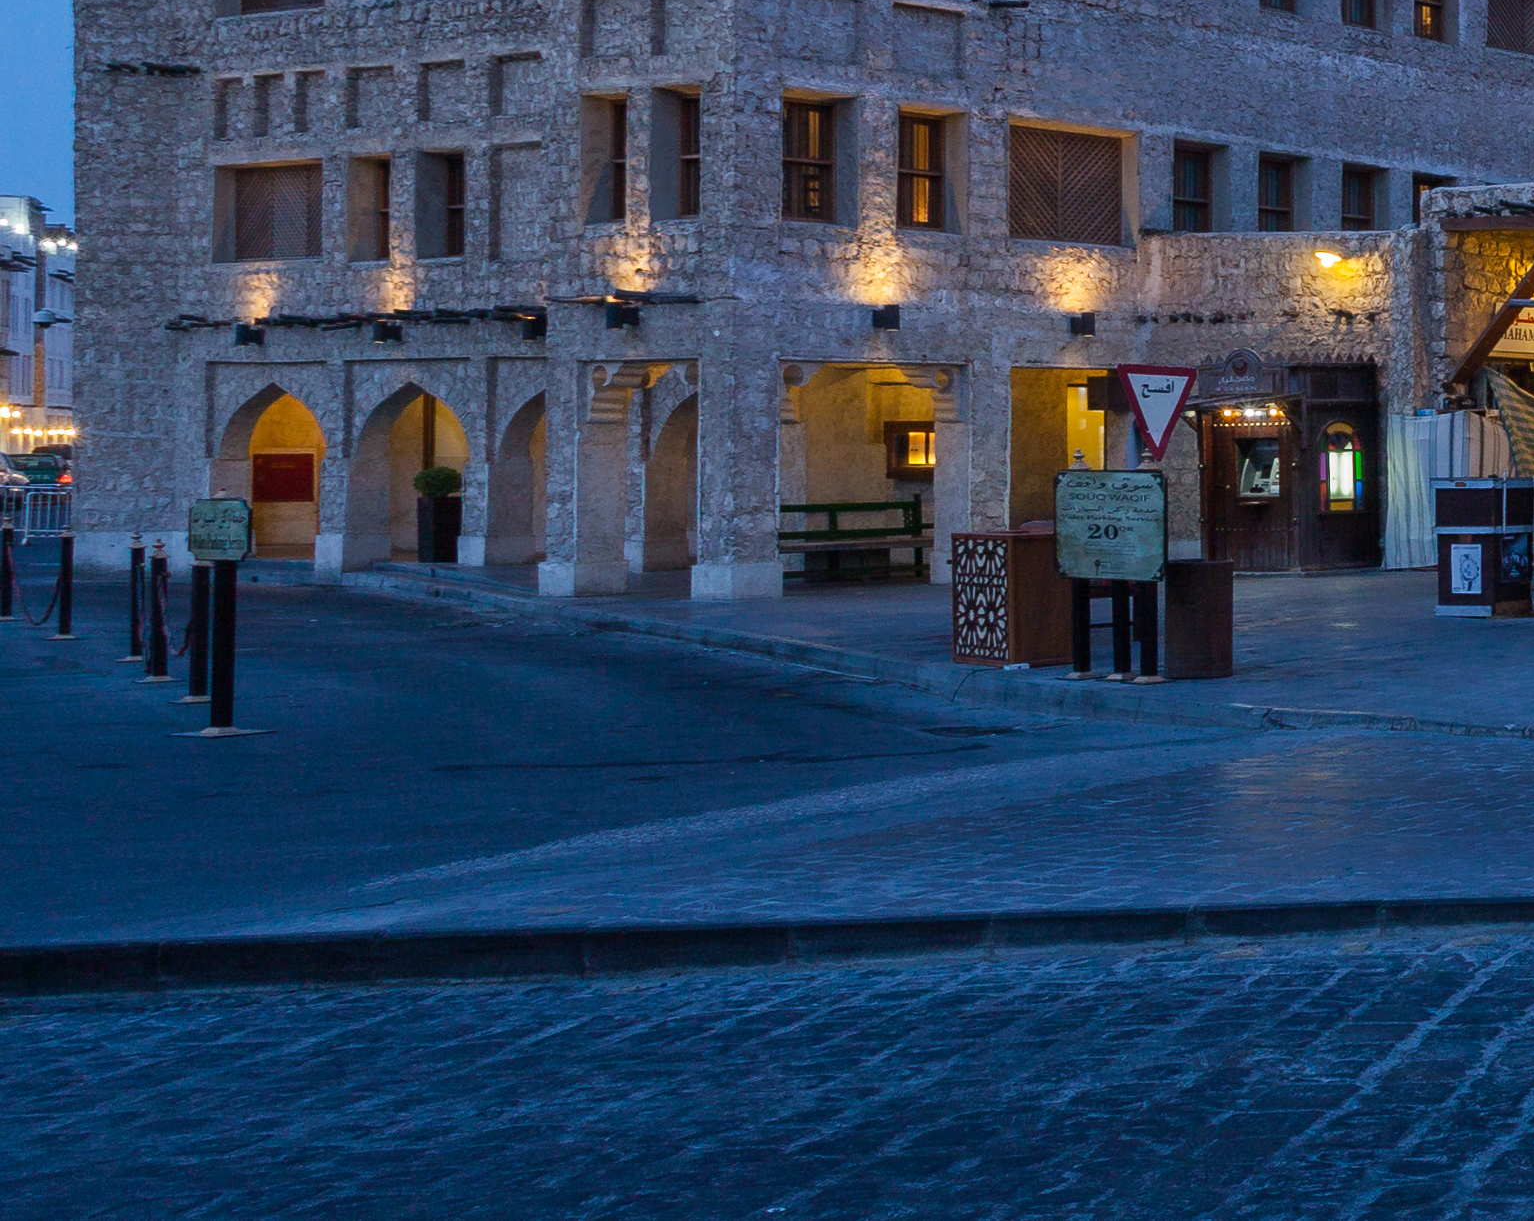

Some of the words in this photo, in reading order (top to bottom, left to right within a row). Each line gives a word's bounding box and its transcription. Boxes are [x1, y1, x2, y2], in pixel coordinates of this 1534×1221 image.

[1141, 379, 1175, 398] افسح
[1112, 477, 1154, 492] سوق
[1068, 492, 1107, 502] SOUQ
[1108, 493, 1151, 502] WAQIF
[1087, 523, 1119, 540] 20
